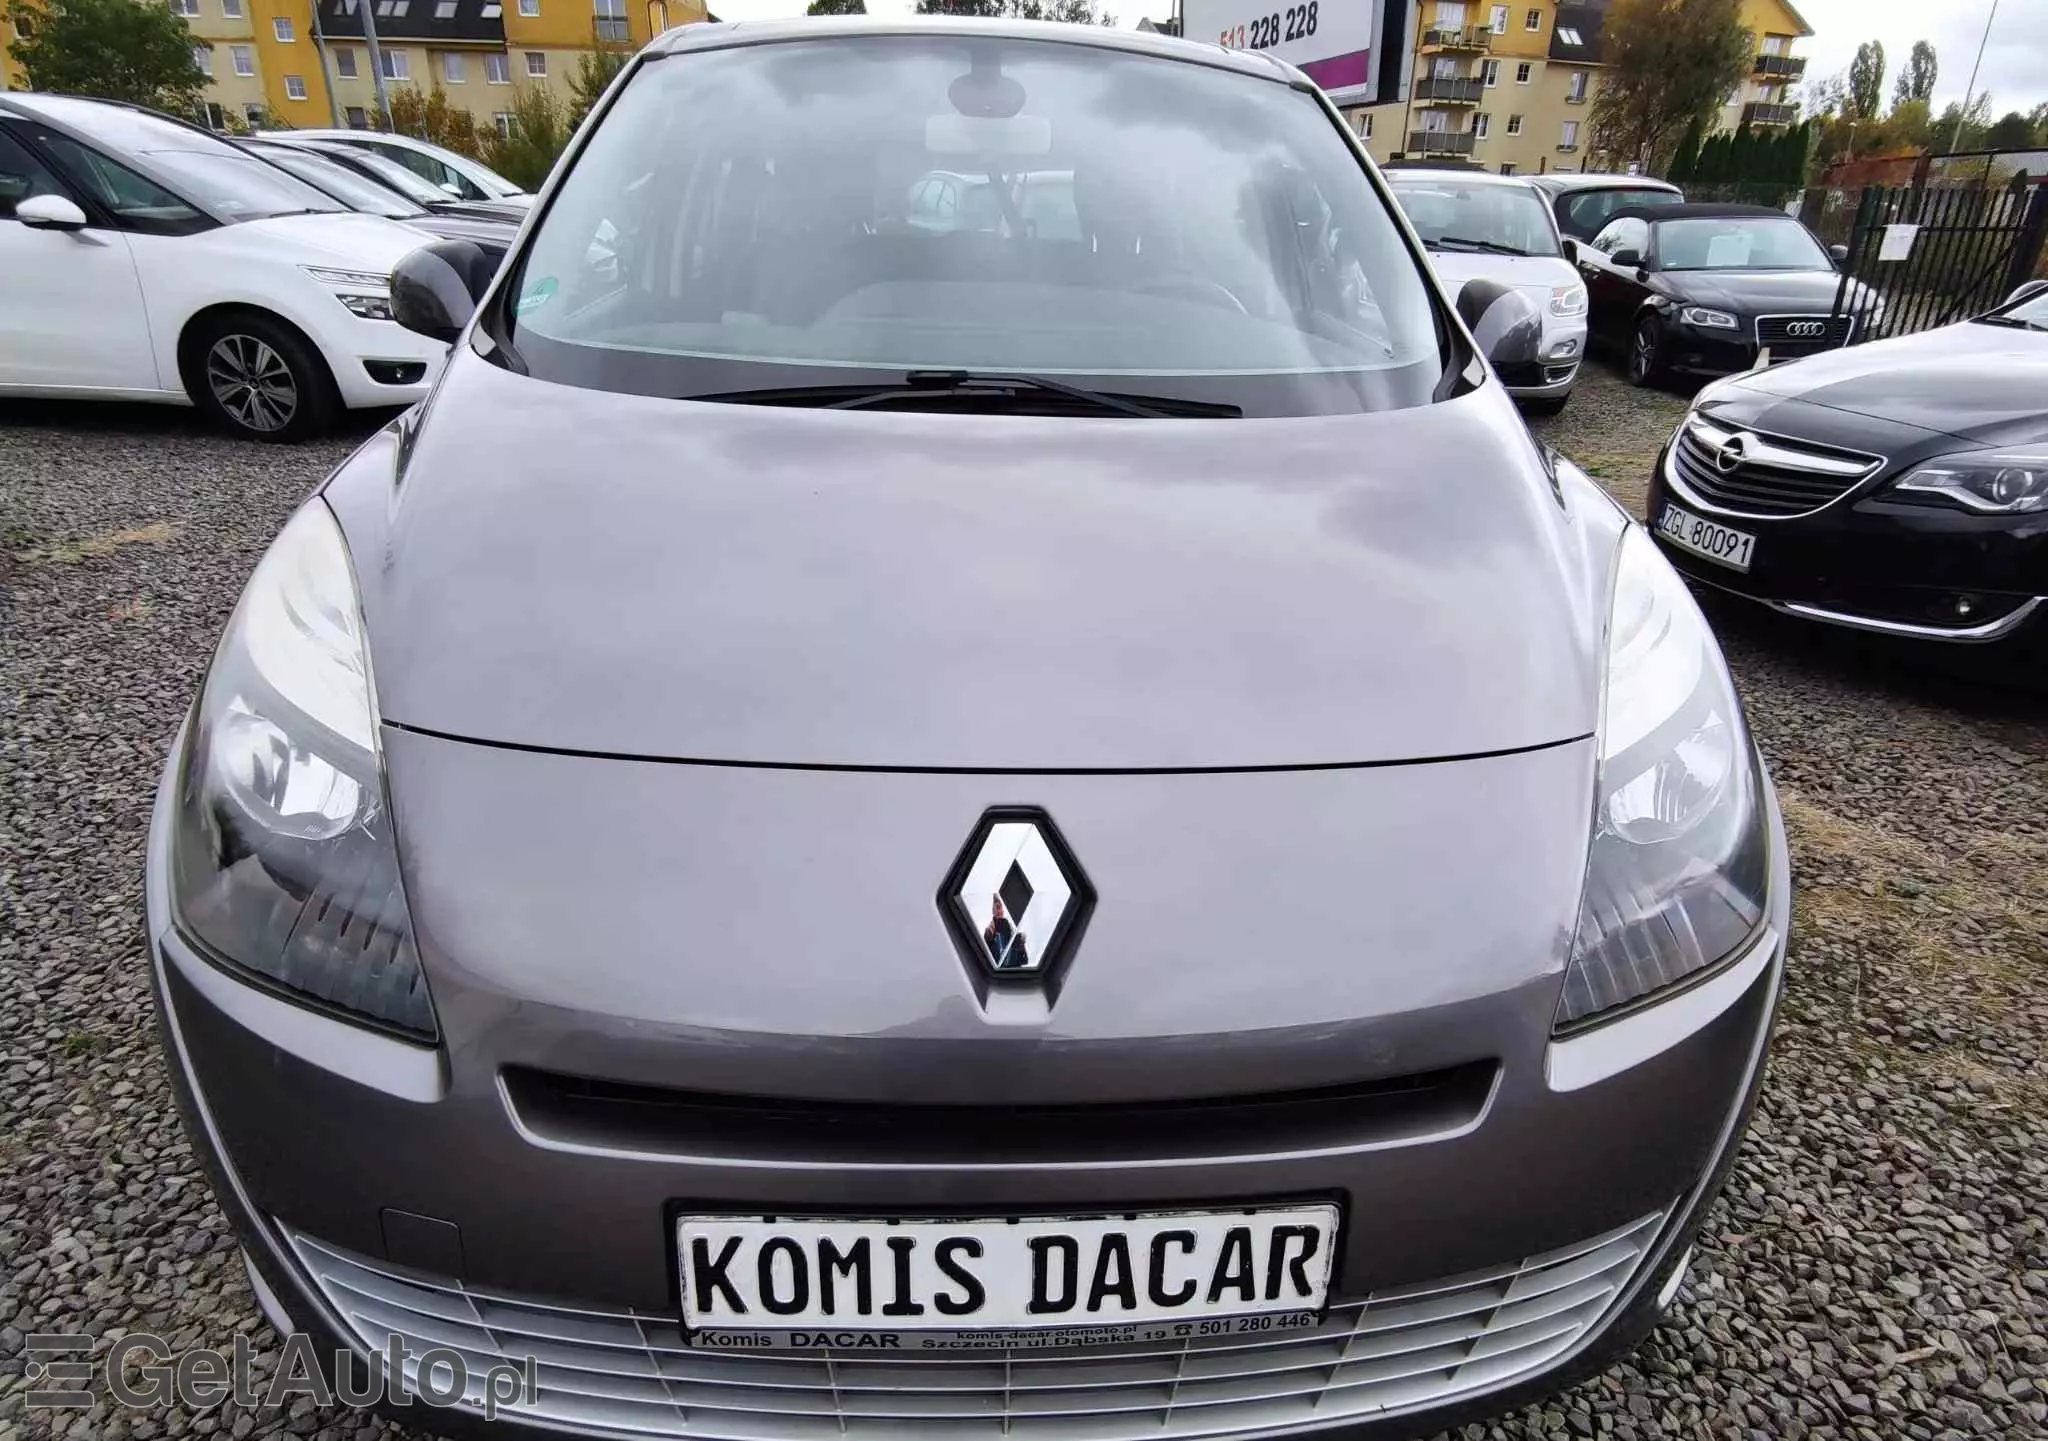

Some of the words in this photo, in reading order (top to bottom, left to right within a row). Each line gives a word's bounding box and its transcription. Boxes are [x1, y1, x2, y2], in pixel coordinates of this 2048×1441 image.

[1250, 13, 1279, 49] 228
[1285, 1, 1318, 41] 228
[1663, 506, 1686, 540] ZGL
[1692, 521, 1750, 563] 80091
[692, 1236, 985, 1315] KOMIS
[1027, 1226, 1320, 1315] DACAR
[702, 1331, 772, 1347] Komis
[790, 1333, 900, 1348] DACAR
[922, 1338, 1019, 1349] Szczecin
[1144, 1329, 1166, 1339] 19
[1200, 1319, 1231, 1335] 501
[1239, 1316, 1271, 1332] 280
[1277, 1313, 1310, 1328] 446
